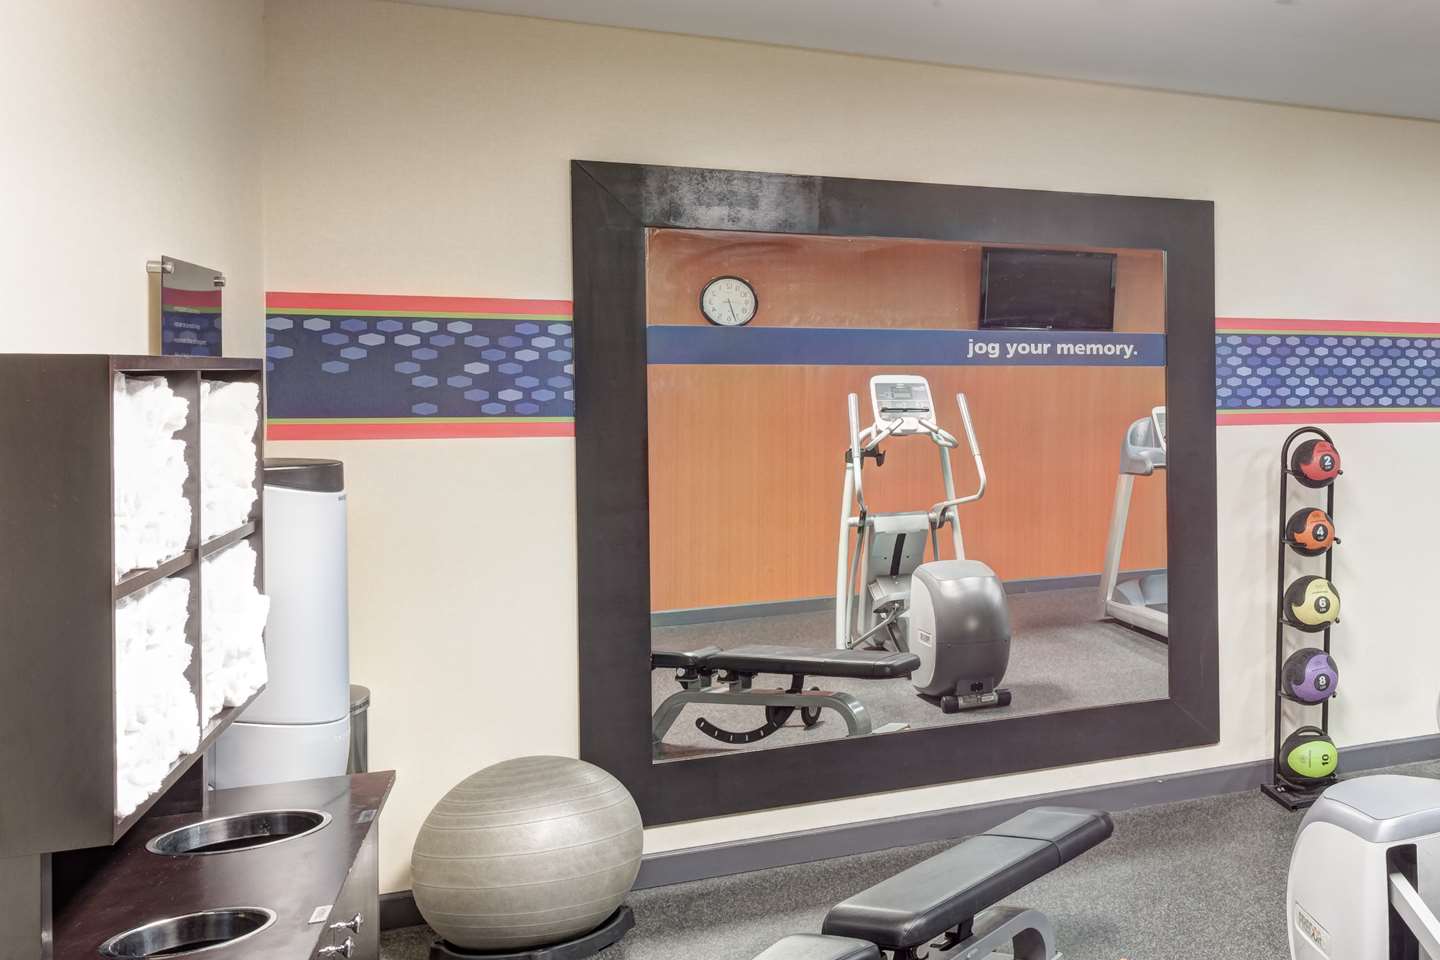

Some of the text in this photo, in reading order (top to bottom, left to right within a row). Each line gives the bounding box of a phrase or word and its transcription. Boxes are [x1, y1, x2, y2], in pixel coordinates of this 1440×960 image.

[967, 339, 1138, 359] jog your memory.
[1323, 455, 1333, 466] 2
[1316, 525, 1326, 536] 4
[1318, 597, 1327, 608] 6
[1318, 675, 1327, 686] 8
[1321, 754, 1330, 766] 10
